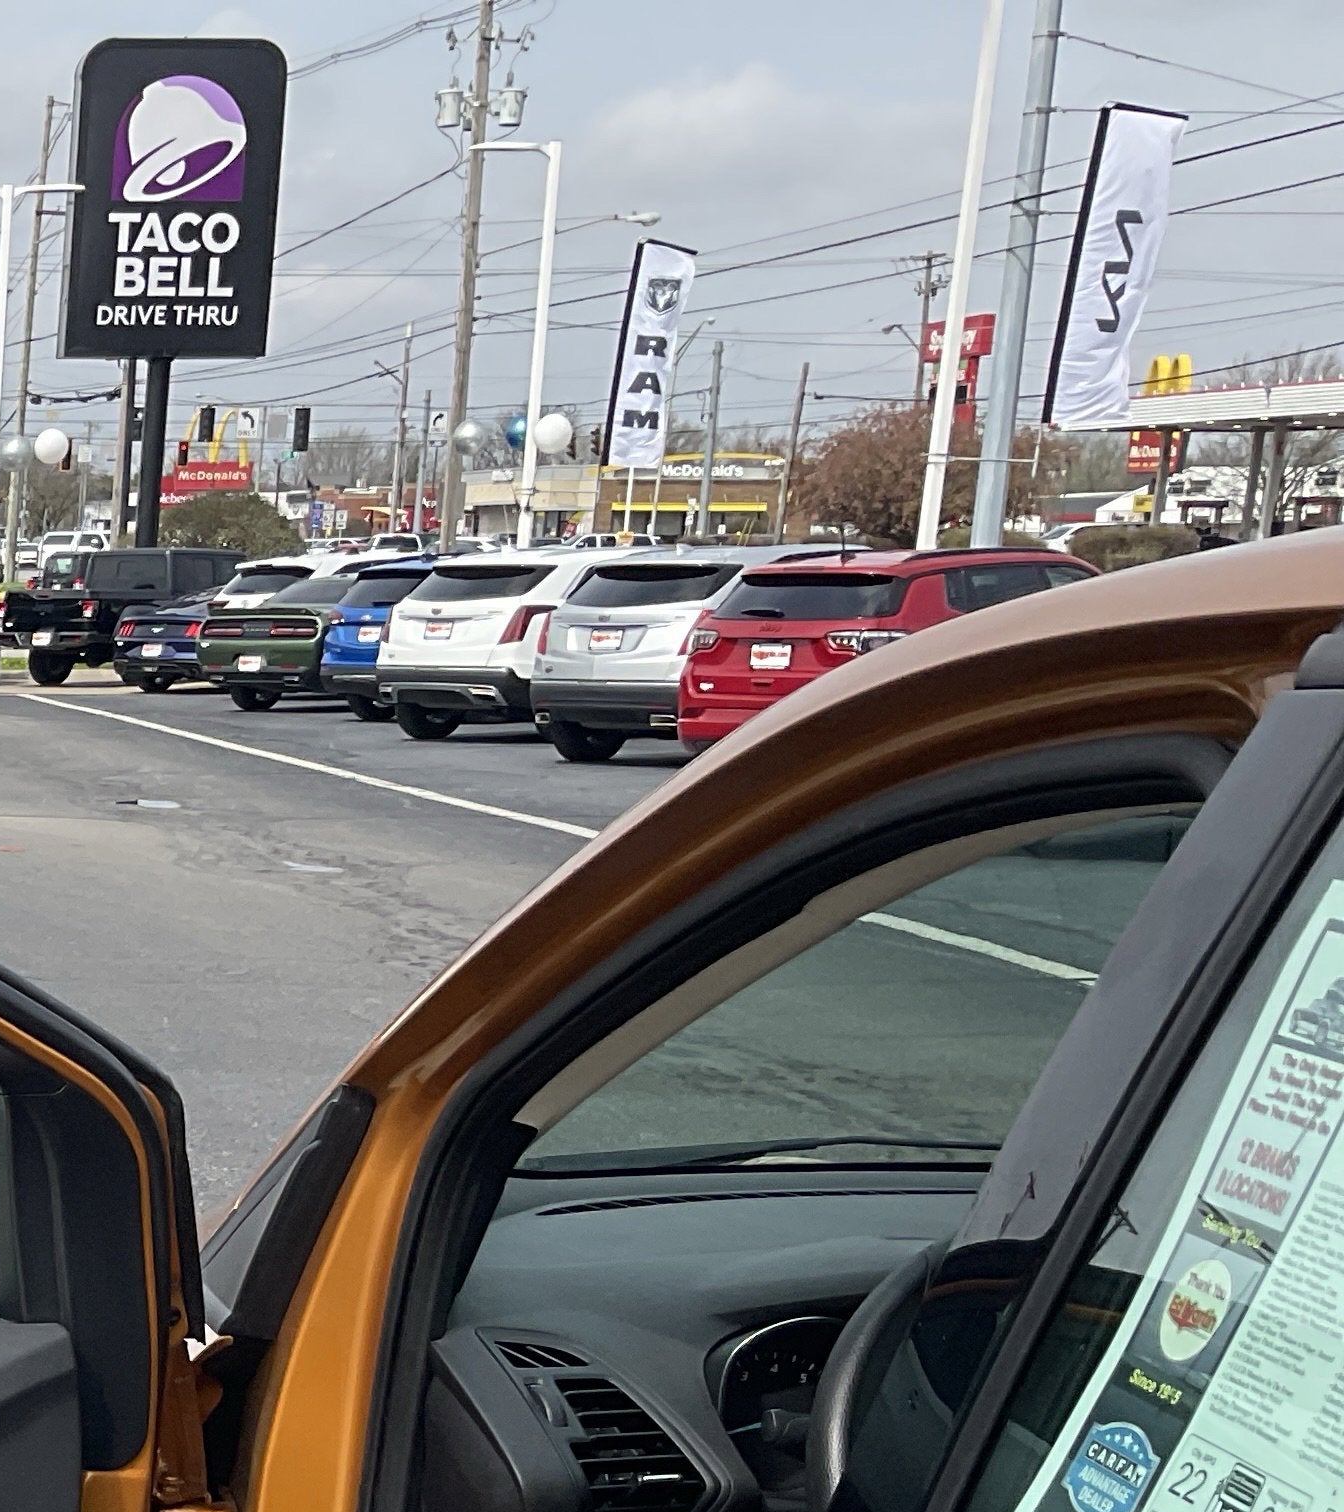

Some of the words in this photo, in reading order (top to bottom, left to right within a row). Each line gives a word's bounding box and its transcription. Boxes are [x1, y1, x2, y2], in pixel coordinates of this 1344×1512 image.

[108, 212, 240, 254] TACO
[113, 256, 234, 298] BELL
[96, 305, 166, 326] DRIVE
[173, 305, 239, 326] THRU
[622, 334, 667, 430] RAM
[178, 470, 247, 480] McDonald's
[662, 464, 744, 477] McDoald's
[1249, 1142, 1301, 1181] BRANDS
[1202, 1213, 1243, 1244] Serving
[1244, 1228, 1263, 1248] You
[1187, 1271, 1211, 1295] Thank
[740, 1371, 749, 1381] 3
[770, 1363, 779, 1373] 4
[799, 1373, 808, 1383] 5
[1129, 1368, 1157, 1393] Since
[1086, 1442, 1148, 1488] CARFAX
[1168, 1461, 1208, 1505] 22
[1078, 1465, 1132, 1504] ADVANTAGE
